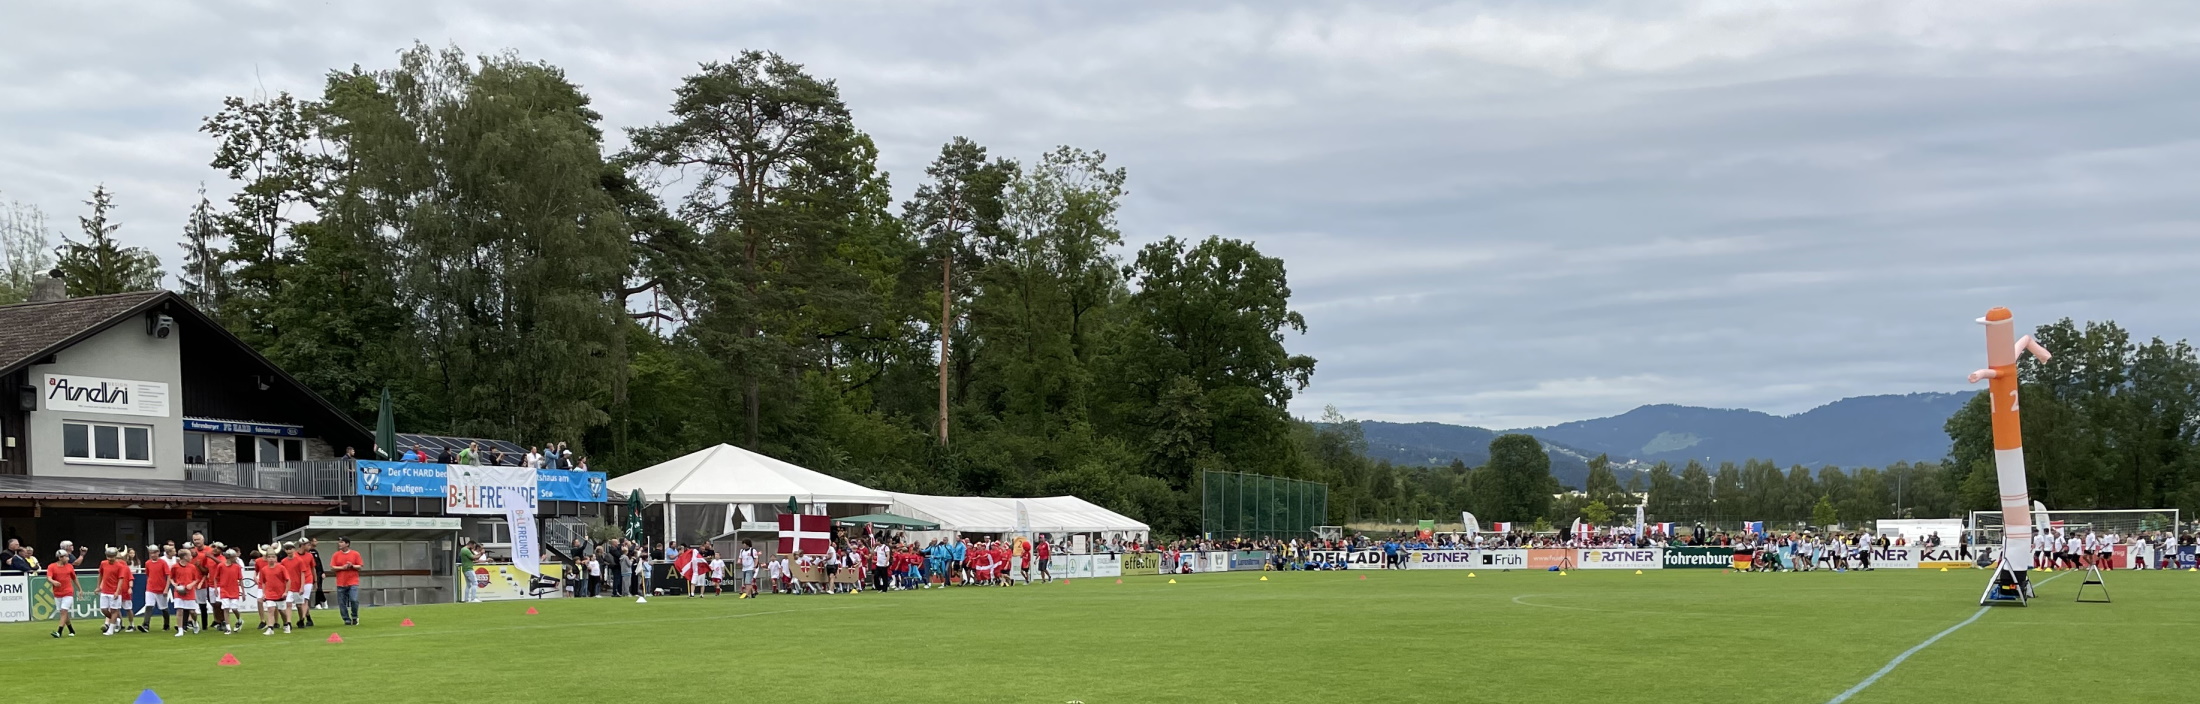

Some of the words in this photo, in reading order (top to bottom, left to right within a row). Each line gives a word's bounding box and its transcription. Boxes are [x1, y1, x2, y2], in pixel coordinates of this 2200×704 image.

[388, 467, 400, 476] Der
[402, 468, 411, 476] FC
[413, 469, 434, 477] HARD
[392, 483, 423, 494] heutigen
[1125, 556, 1156, 569] effectiv
[1495, 554, 1521, 564] Früh
[1664, 550, 1734, 567] fohrenburg
